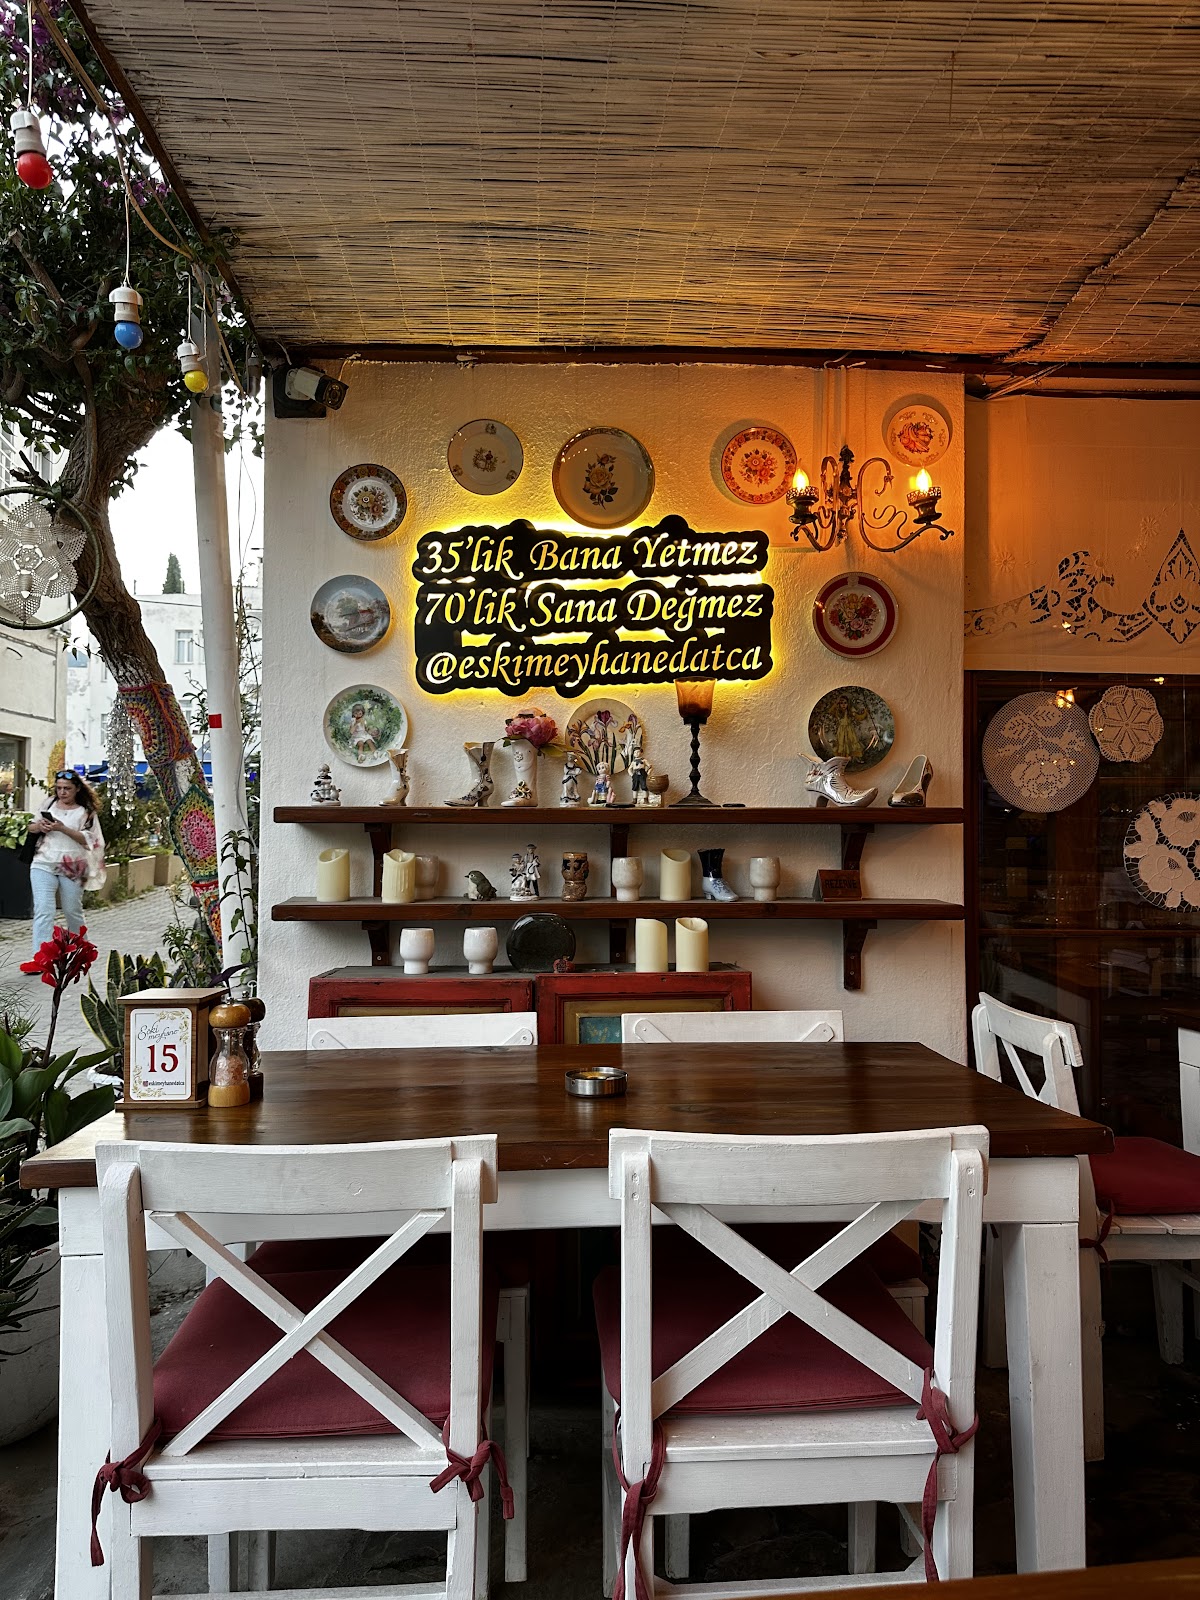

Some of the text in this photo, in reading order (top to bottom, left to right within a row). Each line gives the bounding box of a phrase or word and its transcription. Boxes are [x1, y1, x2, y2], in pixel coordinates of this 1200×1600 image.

[423, 532, 758, 581] 35'lik Bana Yetmez
[425, 587, 763, 632] 70'lik Sana Değmez
[425, 637, 763, 688] @eskimeyhanedatca
[825, 879, 857, 889] REZERVE
[147, 1044, 179, 1073] 15
